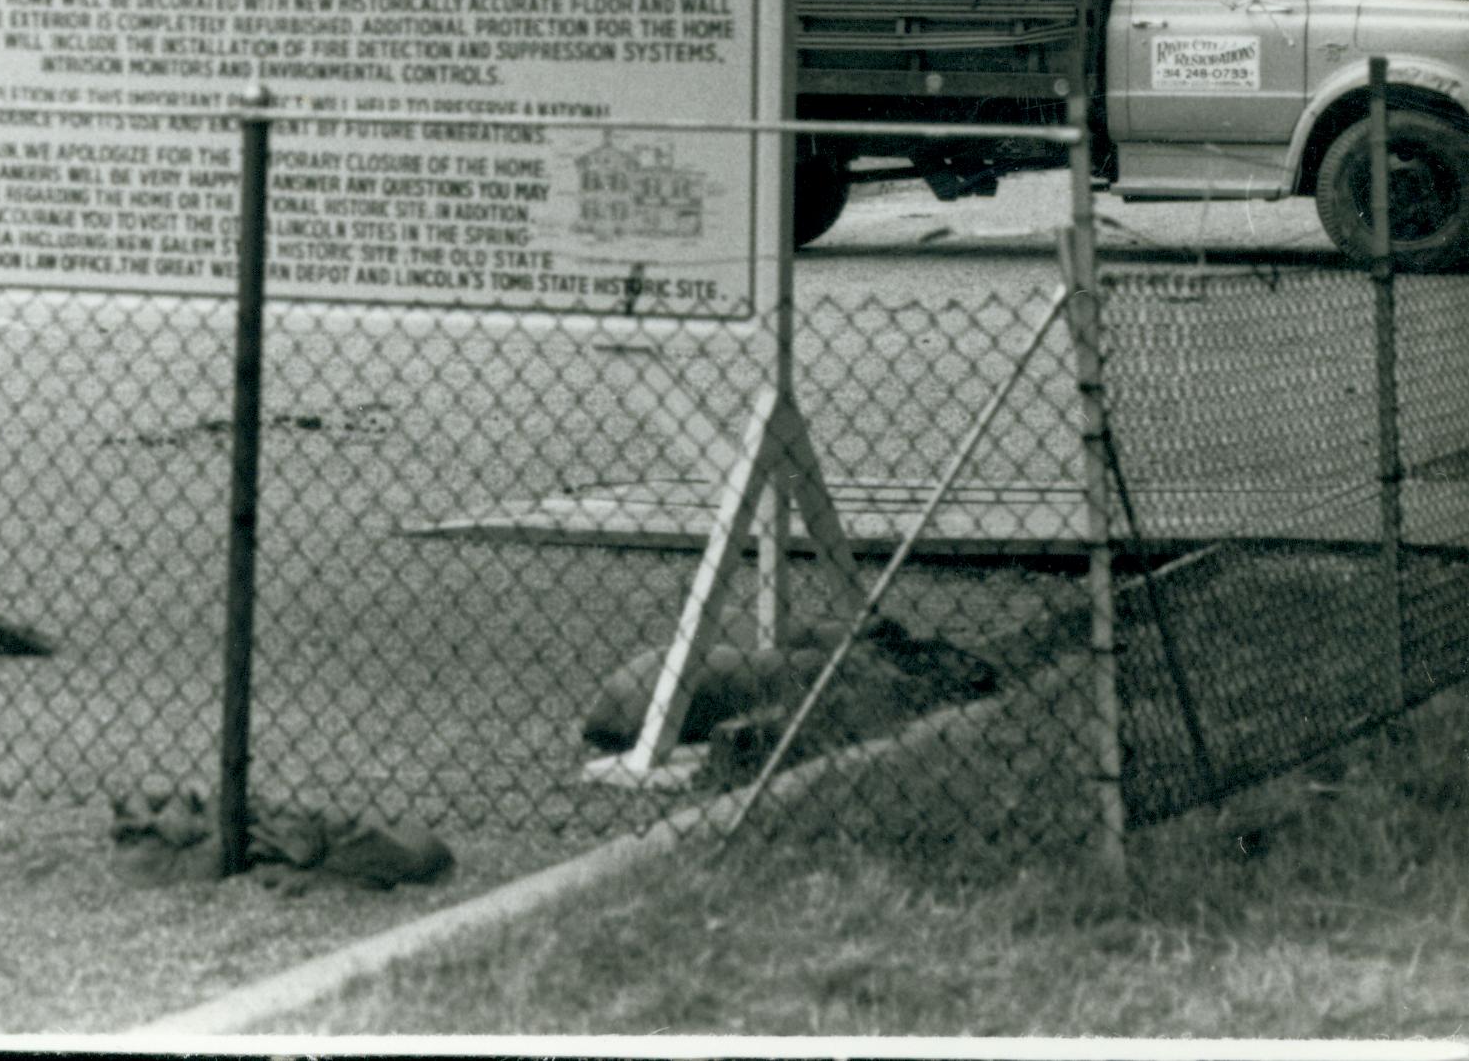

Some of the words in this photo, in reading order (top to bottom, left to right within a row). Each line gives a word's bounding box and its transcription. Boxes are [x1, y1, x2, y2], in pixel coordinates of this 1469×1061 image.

[10, 10, 91, 29] EXTERIOR
[96, 11, 112, 31] IS
[117, 13, 226, 33] COMPLETELY
[361, 16, 468, 37] ADDITIONAL
[475, 16, 589, 38] PROTECTION
[594, 18, 633, 37] FOR
[640, 18, 676, 42] THE
[682, 19, 734, 39] HOME
[4, 32, 43, 51] WILL
[52, 33, 117, 52] INCLUDE
[126, 34, 154, 53] THE
[162, 36, 280, 57] INSTALLATION
[283, 39, 305, 57] OF
[312, 39, 349, 58] FIRE
[357, 38, 453, 60] DETECTION
[457, 41, 491, 60] AND
[496, 39, 617, 62] SUPPRESSION
[623, 41, 725, 64] SYSTEMS.
[40, 54, 123, 75] INTRUSION
[129, 57, 213, 77] MONITORS
[217, 60, 252, 79] AND
[258, 60, 395, 82] ENVIRONMENTAL
[401, 63, 502, 85] CONTROLS.
[24, 142, 49, 160] WE
[56, 142, 150, 165] APOLOGIZE
[156, 145, 192, 166] FOR
[198, 146, 231, 167] THE
[345, 152, 423, 175] CLOSURE
[427, 154, 450, 175] OF
[456, 156, 488, 176] THE
[67, 166, 102, 185] WILL
[109, 167, 131, 186] BE
[140, 168, 182, 186] VERY
[272, 173, 340, 193] ANSWER
[346, 176, 377, 194] ANY
[382, 177, 474, 199] QUESTIONS
[478, 180, 510, 200] YOU
[514, 182, 550, 201] MAY
[6, 185, 90, 205] REGARDING
[95, 188, 123, 207] THE
[129, 191, 175, 208] HOME
[180, 192, 200, 210] OR
[205, 192, 234, 211] THE
[324, 197, 390, 217] HISTORIC
[436, 202, 451, 219] IN
[80, 210, 112, 229] YOU
[116, 210, 134, 230] TO
[136, 211, 178, 232] VISIT
[185, 213, 213, 233] THE
[276, 218, 346, 240] LINCOLN
[351, 220, 397, 241] SITES
[402, 223, 419, 242] IN
[425, 223, 458, 244] THE
[161, 236, 216, 256] SALEM
[280, 240, 353, 261] HISTORIC
[409, 246, 445, 264] THE
[449, 247, 488, 268] OLD
[493, 248, 554, 270] STATE
[121, 255, 150, 275] THE
[154, 256, 204, 278] GREAT
[295, 262, 351, 284] DEPOT
[355, 266, 390, 286] AND
[395, 267, 485, 291] LINCOLN'S
[490, 271, 534, 292] TOMB
[537, 272, 589, 295] STATE
[675, 278, 727, 302] SITE.
